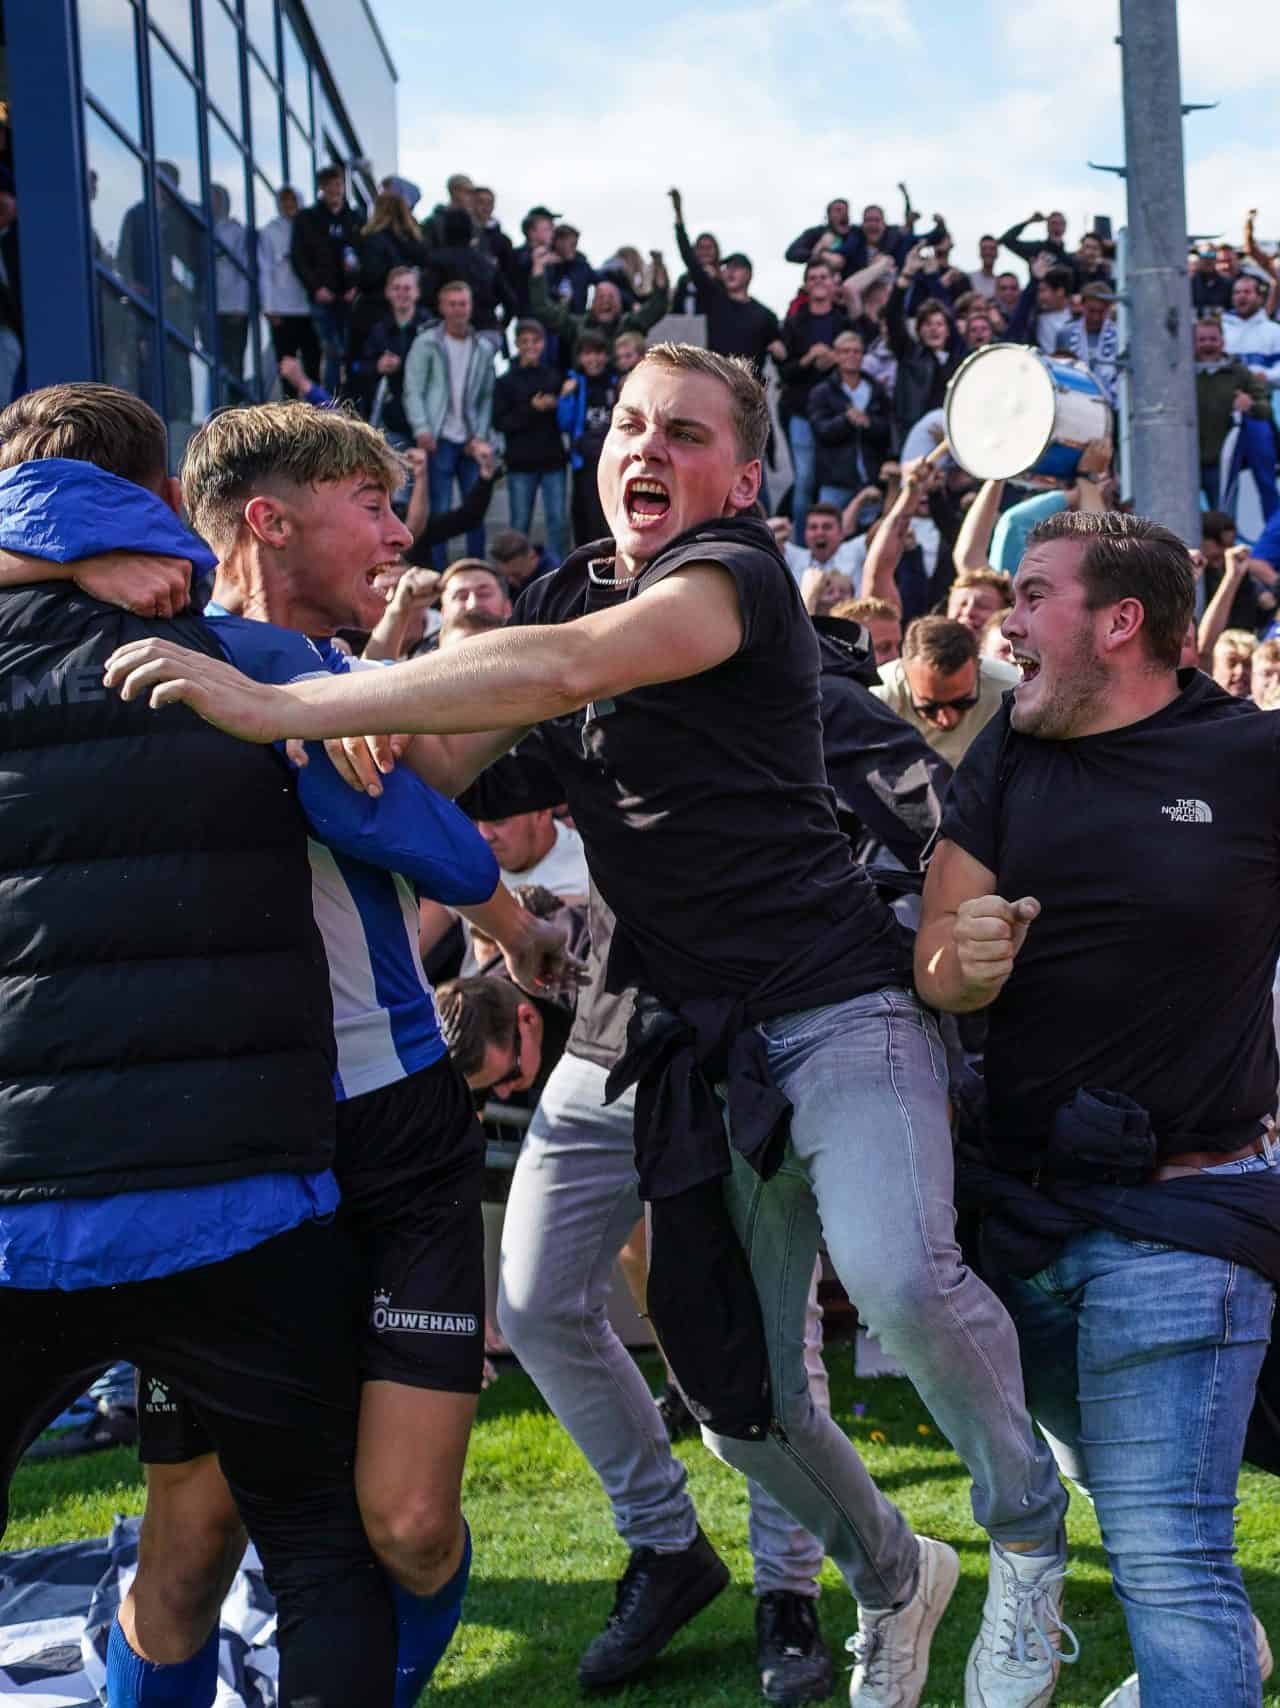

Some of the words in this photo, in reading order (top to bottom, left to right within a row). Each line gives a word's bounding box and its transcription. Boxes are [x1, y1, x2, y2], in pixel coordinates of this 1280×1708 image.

[0, 664, 106, 712] ME
[1176, 799, 1196, 807] THE
[1161, 806, 1195, 816] NORTH
[1171, 814, 1195, 822] FACE
[374, 1307, 476, 1332] OUWEHAND
